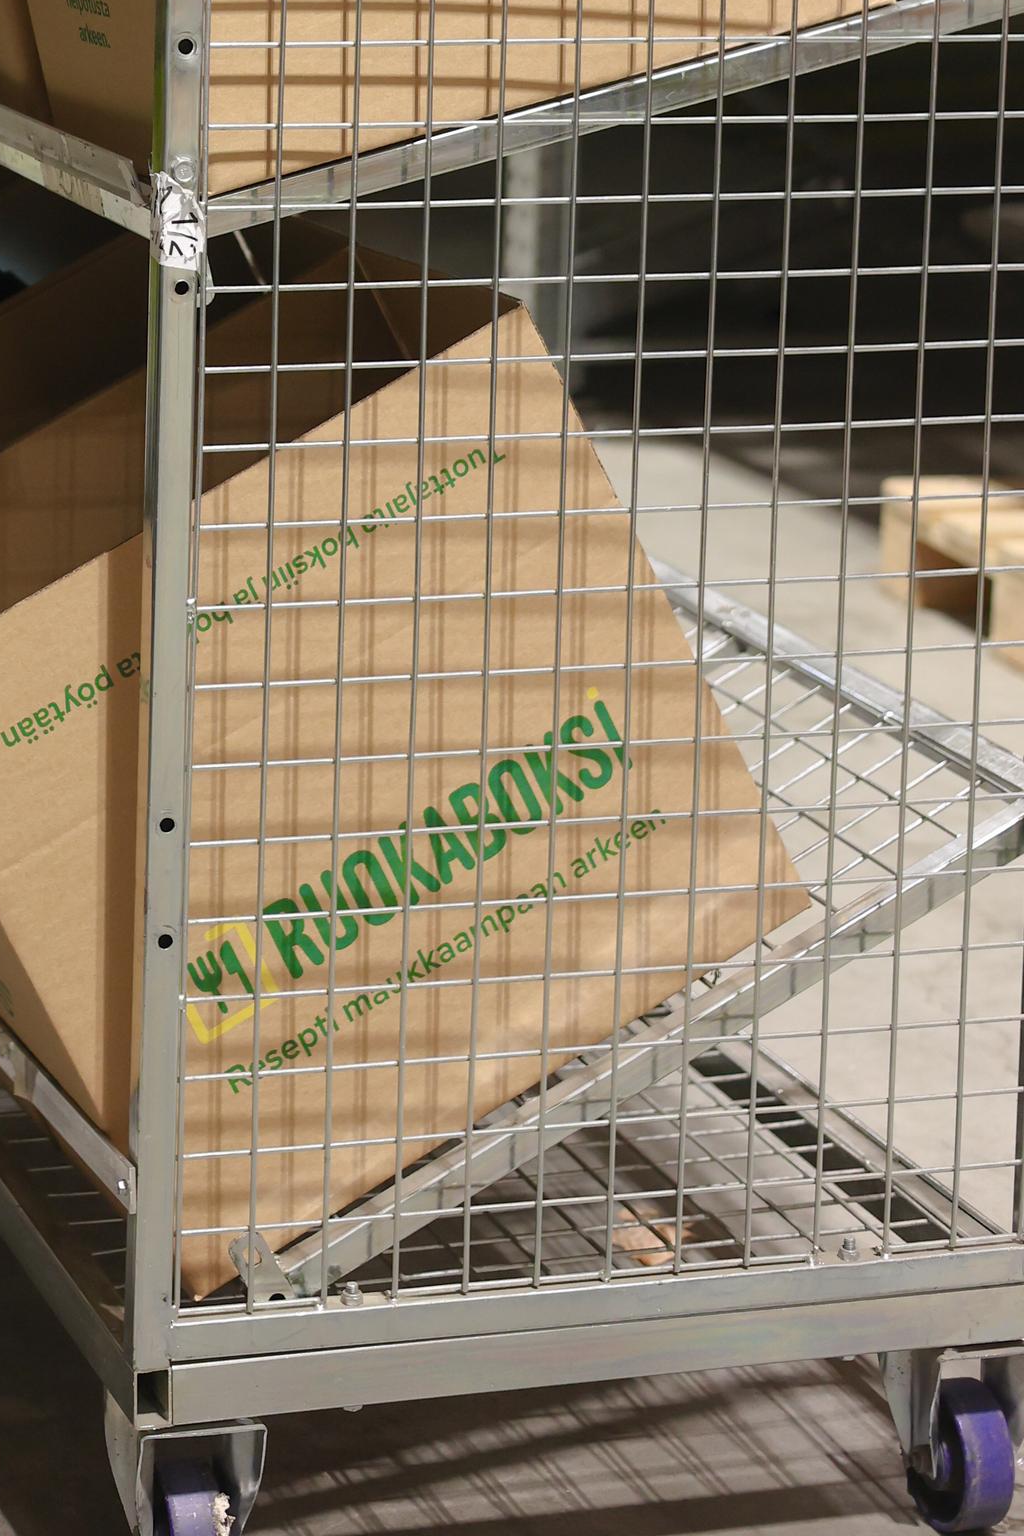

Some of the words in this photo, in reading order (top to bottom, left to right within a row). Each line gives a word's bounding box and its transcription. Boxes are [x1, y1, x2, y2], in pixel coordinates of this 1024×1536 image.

[360, 444, 506, 534] Tuottajalta
[232, 575, 260, 606] ja
[261, 526, 360, 591] boksiin
[0, 664, 115, 748] pöytään
[262, 688, 634, 980] RUOKABOKSI
[341, 870, 568, 1023] maukkaampaan
[569, 808, 667, 879] arkeen
